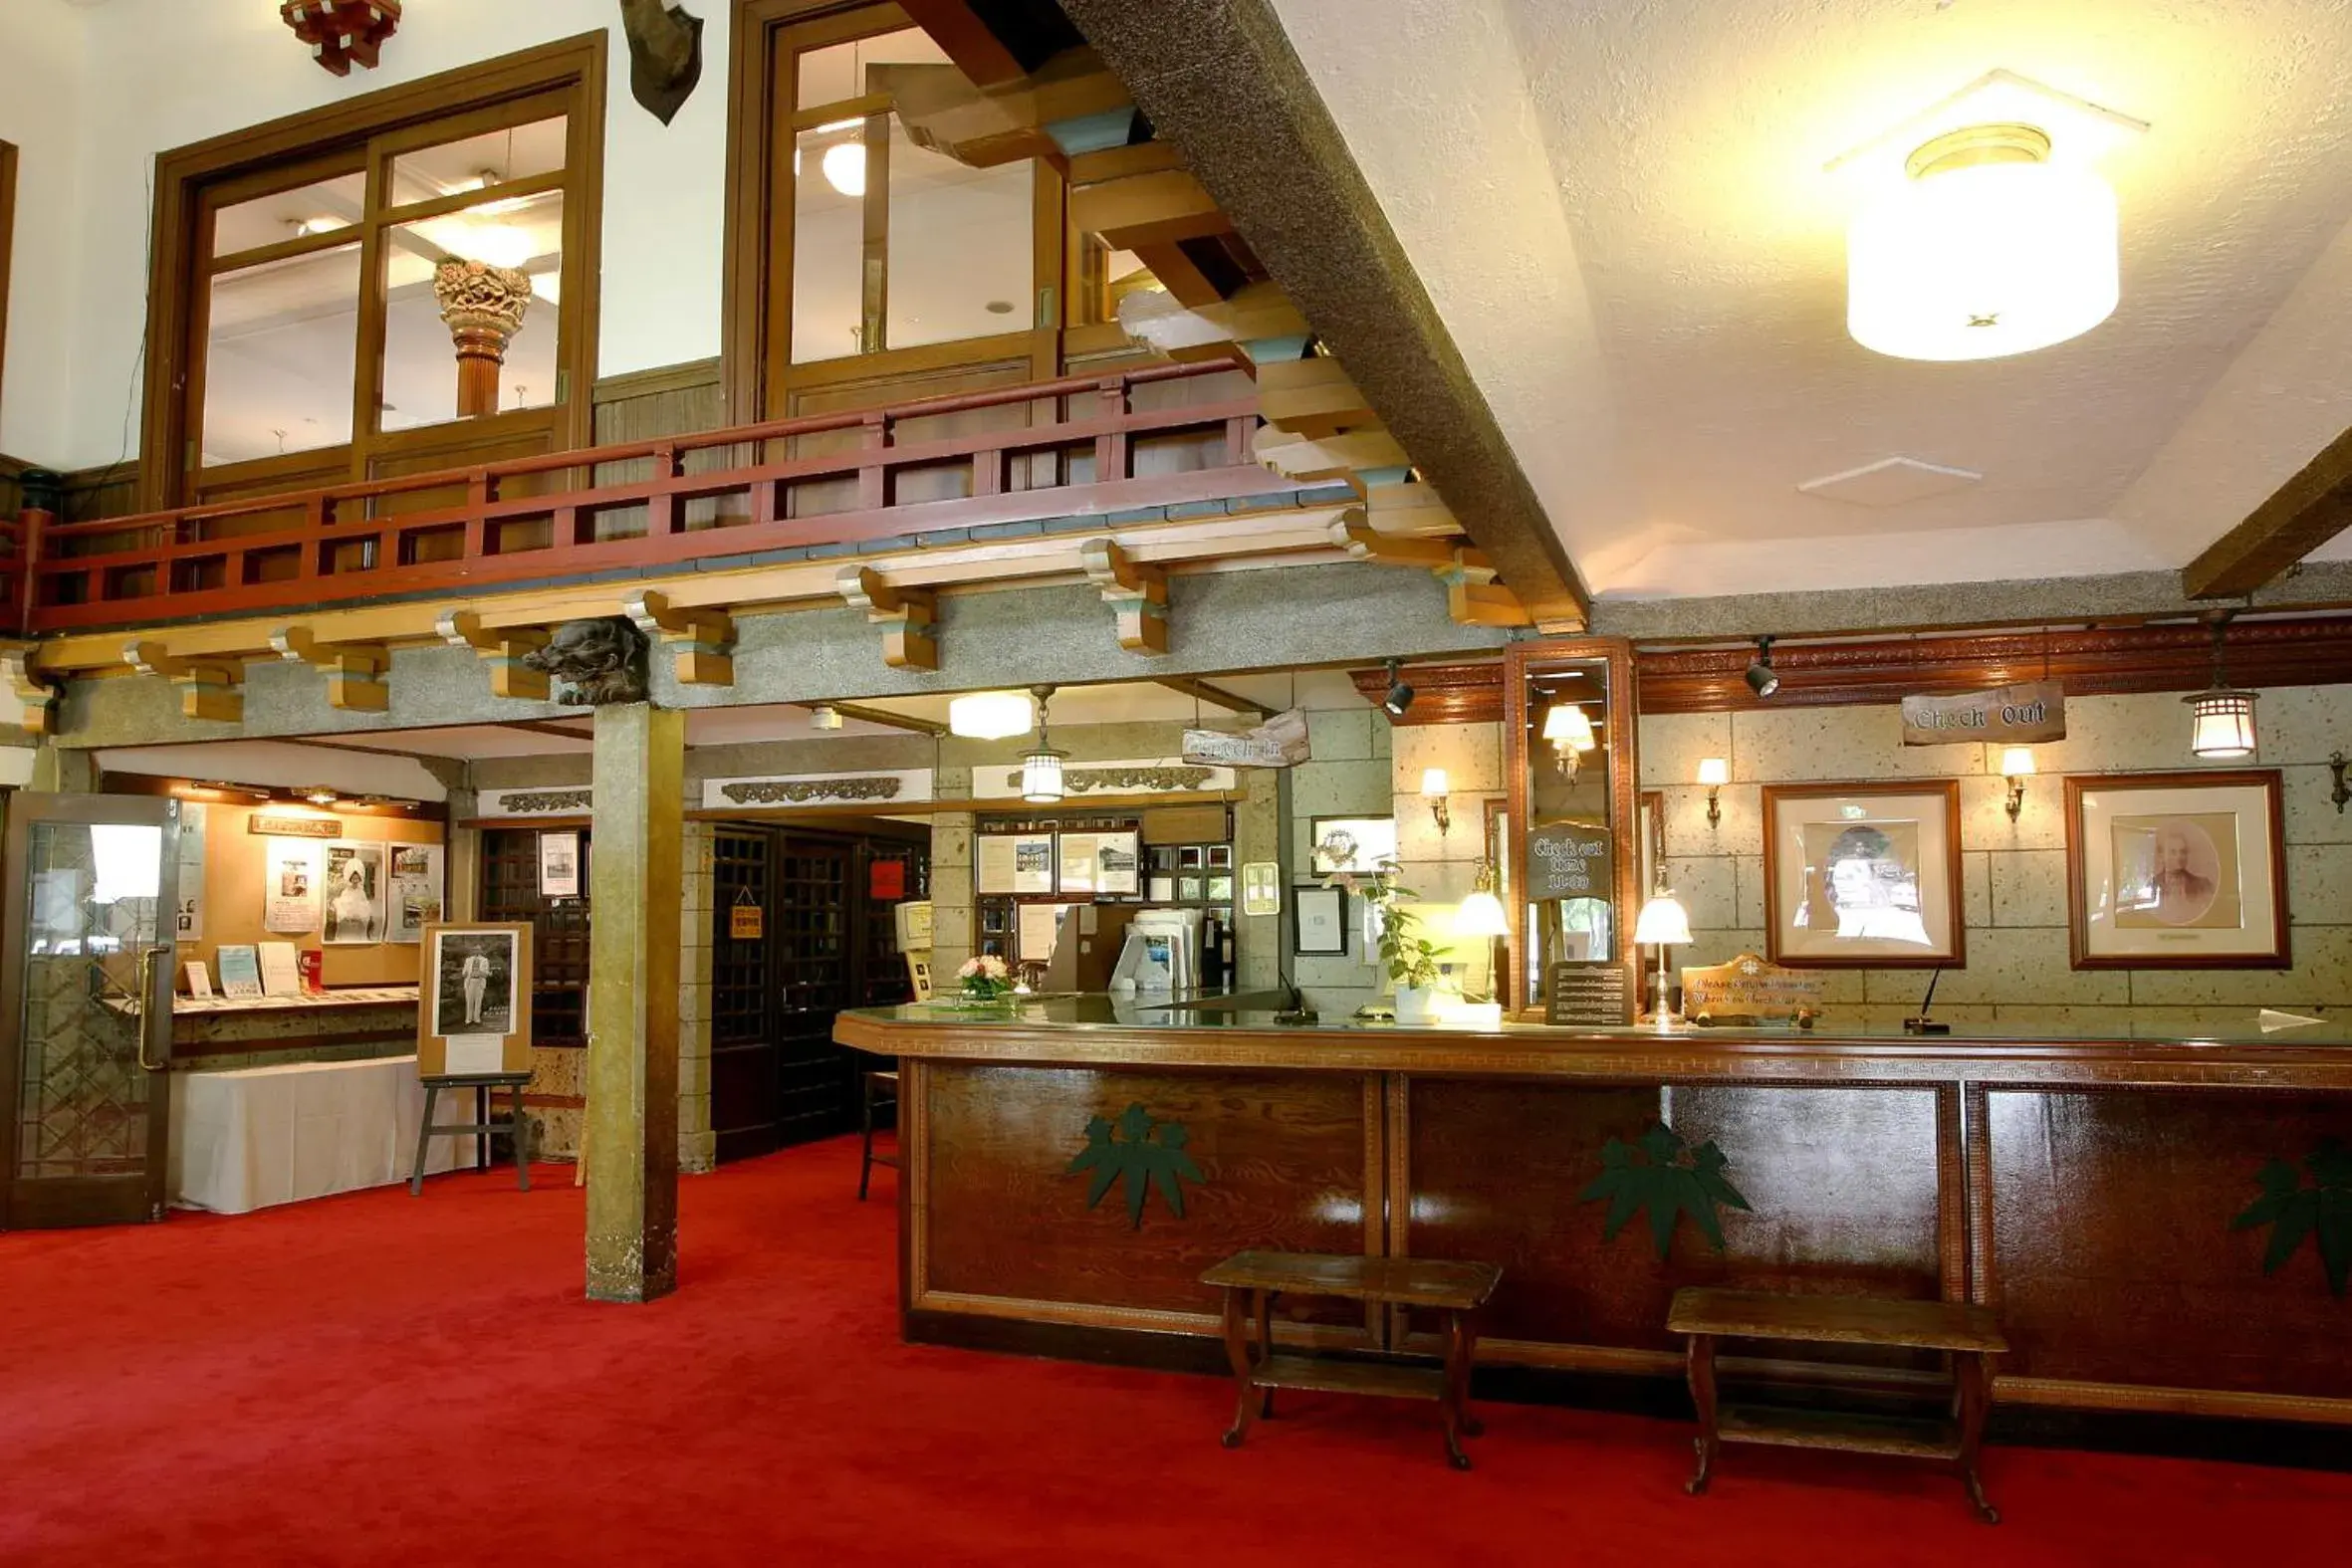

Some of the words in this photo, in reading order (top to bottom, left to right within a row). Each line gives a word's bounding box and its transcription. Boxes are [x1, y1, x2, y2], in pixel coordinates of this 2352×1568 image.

[1914, 704, 1986, 730] Check
[2001, 701, 2047, 726] Out
[1534, 837, 1576, 857] Check
